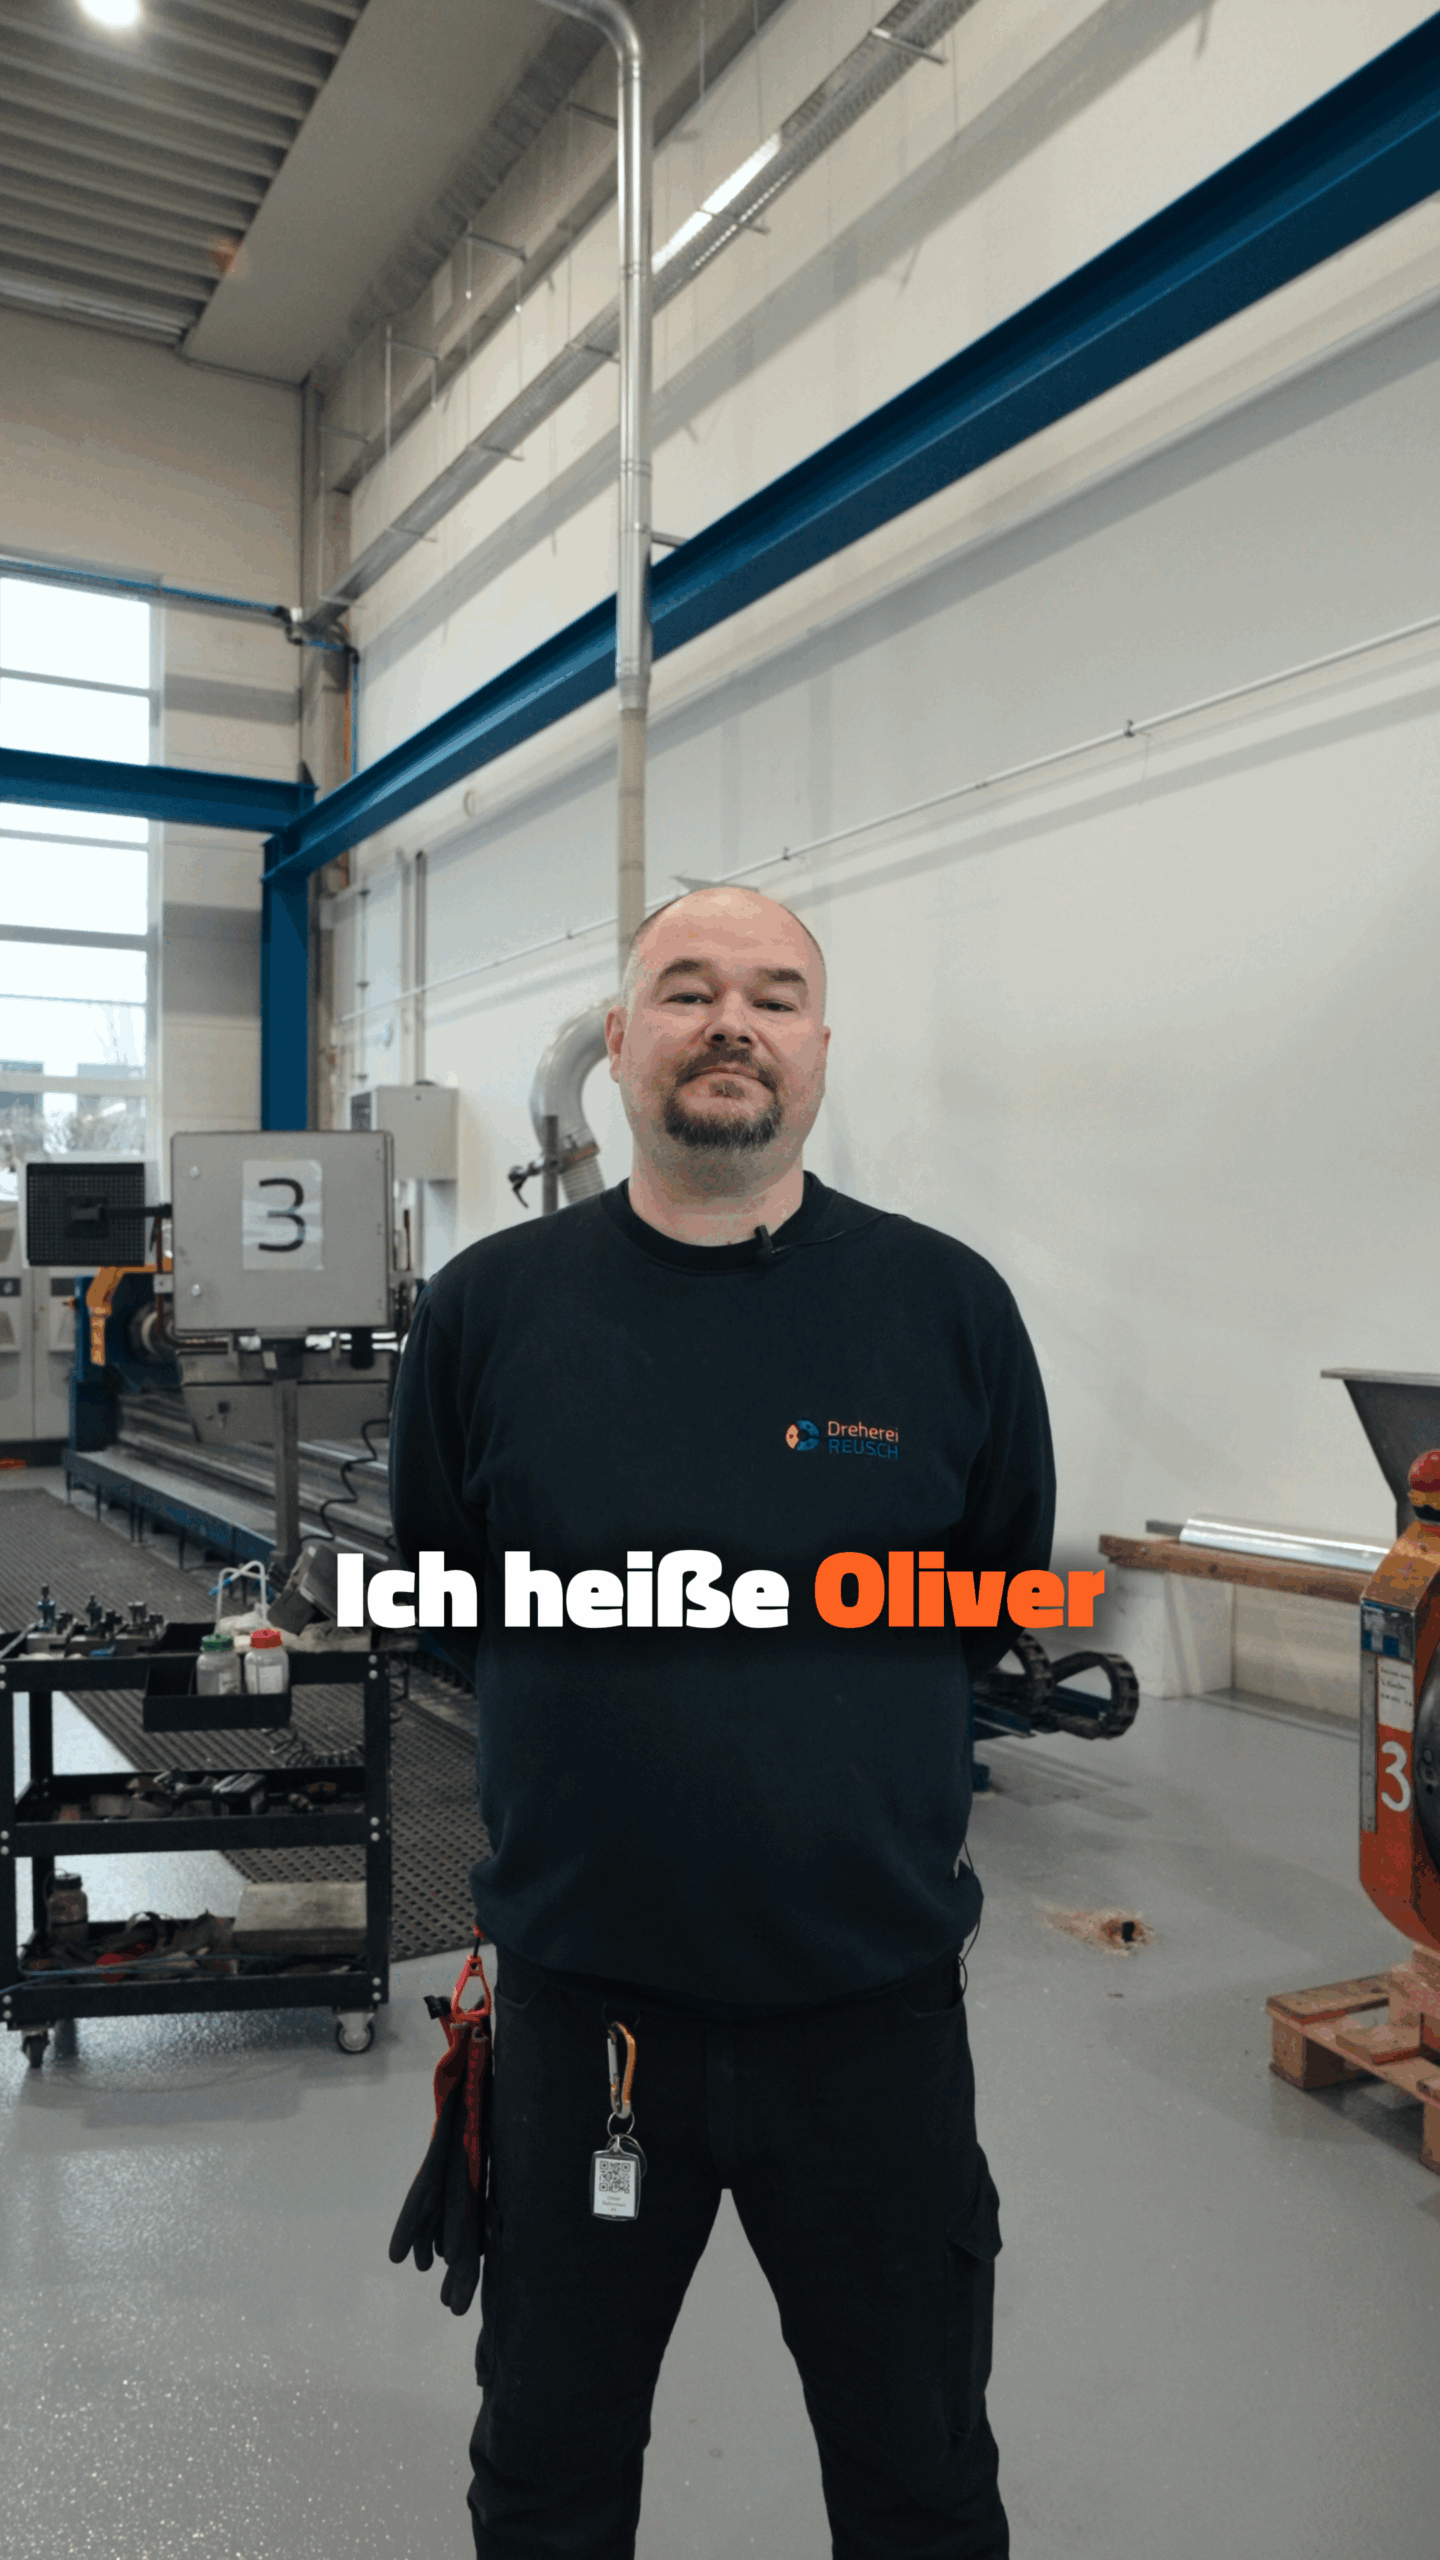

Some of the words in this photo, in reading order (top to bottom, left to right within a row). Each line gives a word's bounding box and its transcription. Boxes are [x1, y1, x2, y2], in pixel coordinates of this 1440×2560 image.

[258, 1178, 305, 1253] 3
[827, 1420, 900, 1443] Dreherei
[828, 1438, 899, 1460] REUSCH
[1381, 1741, 1411, 1812] 3
